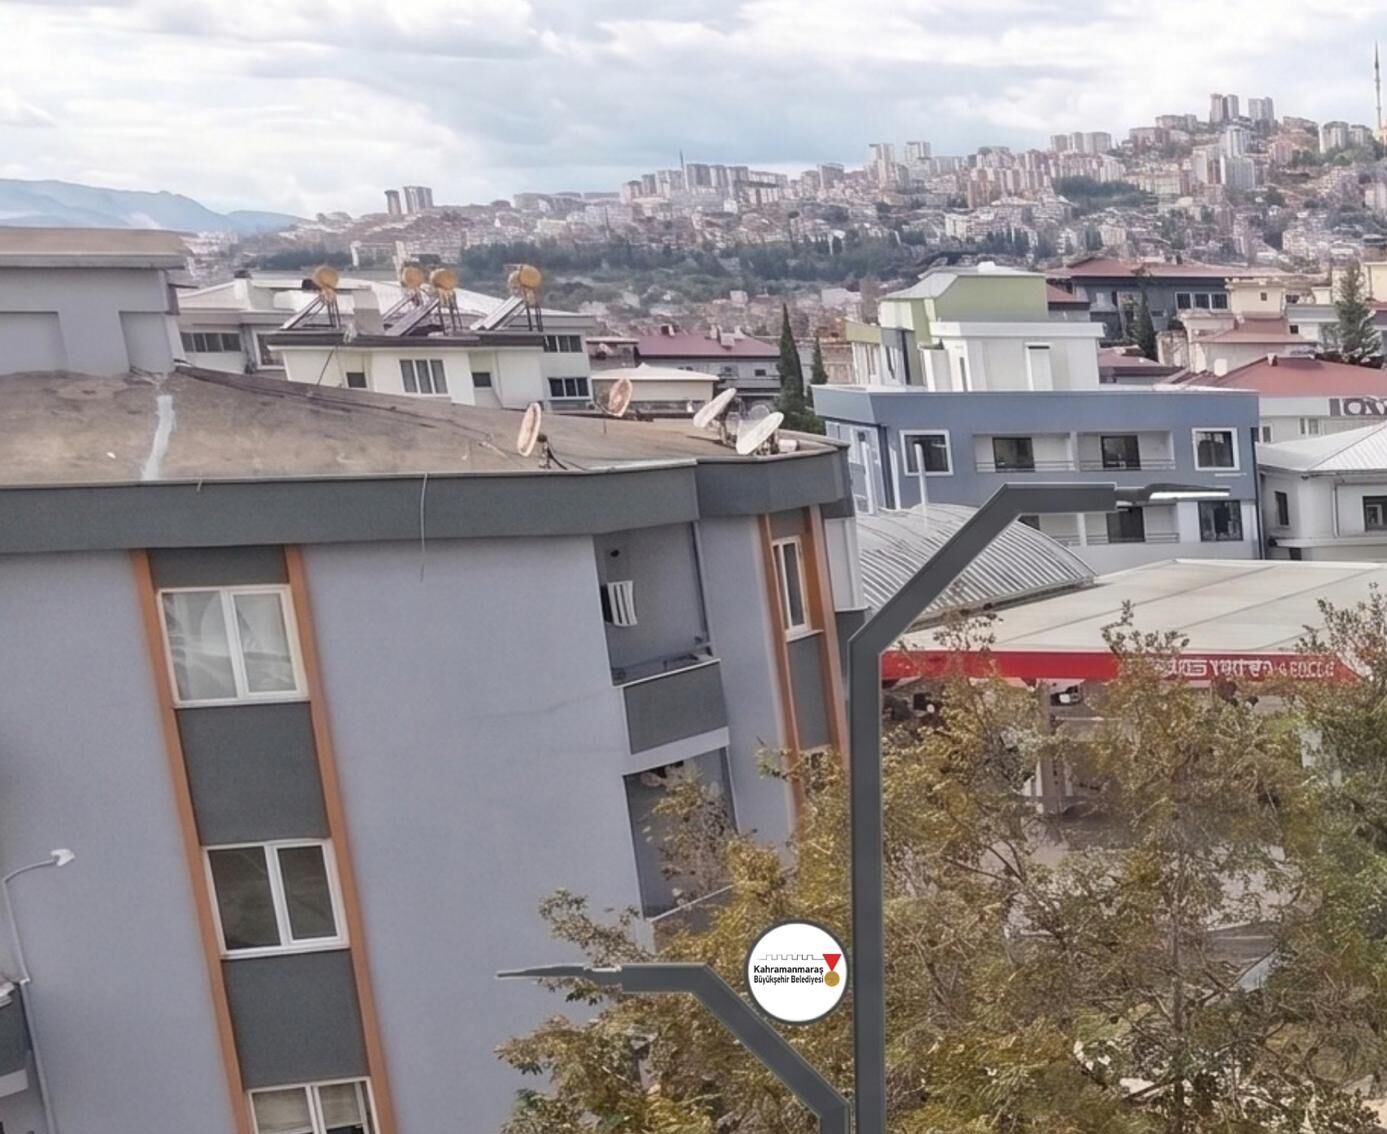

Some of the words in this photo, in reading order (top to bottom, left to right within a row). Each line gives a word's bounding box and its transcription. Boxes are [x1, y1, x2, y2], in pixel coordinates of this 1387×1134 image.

[753, 965, 824, 976] Kahramanmaraş
[753, 975, 790, 986] Büyükşehir
[790, 975, 824, 986] Belediyesi
